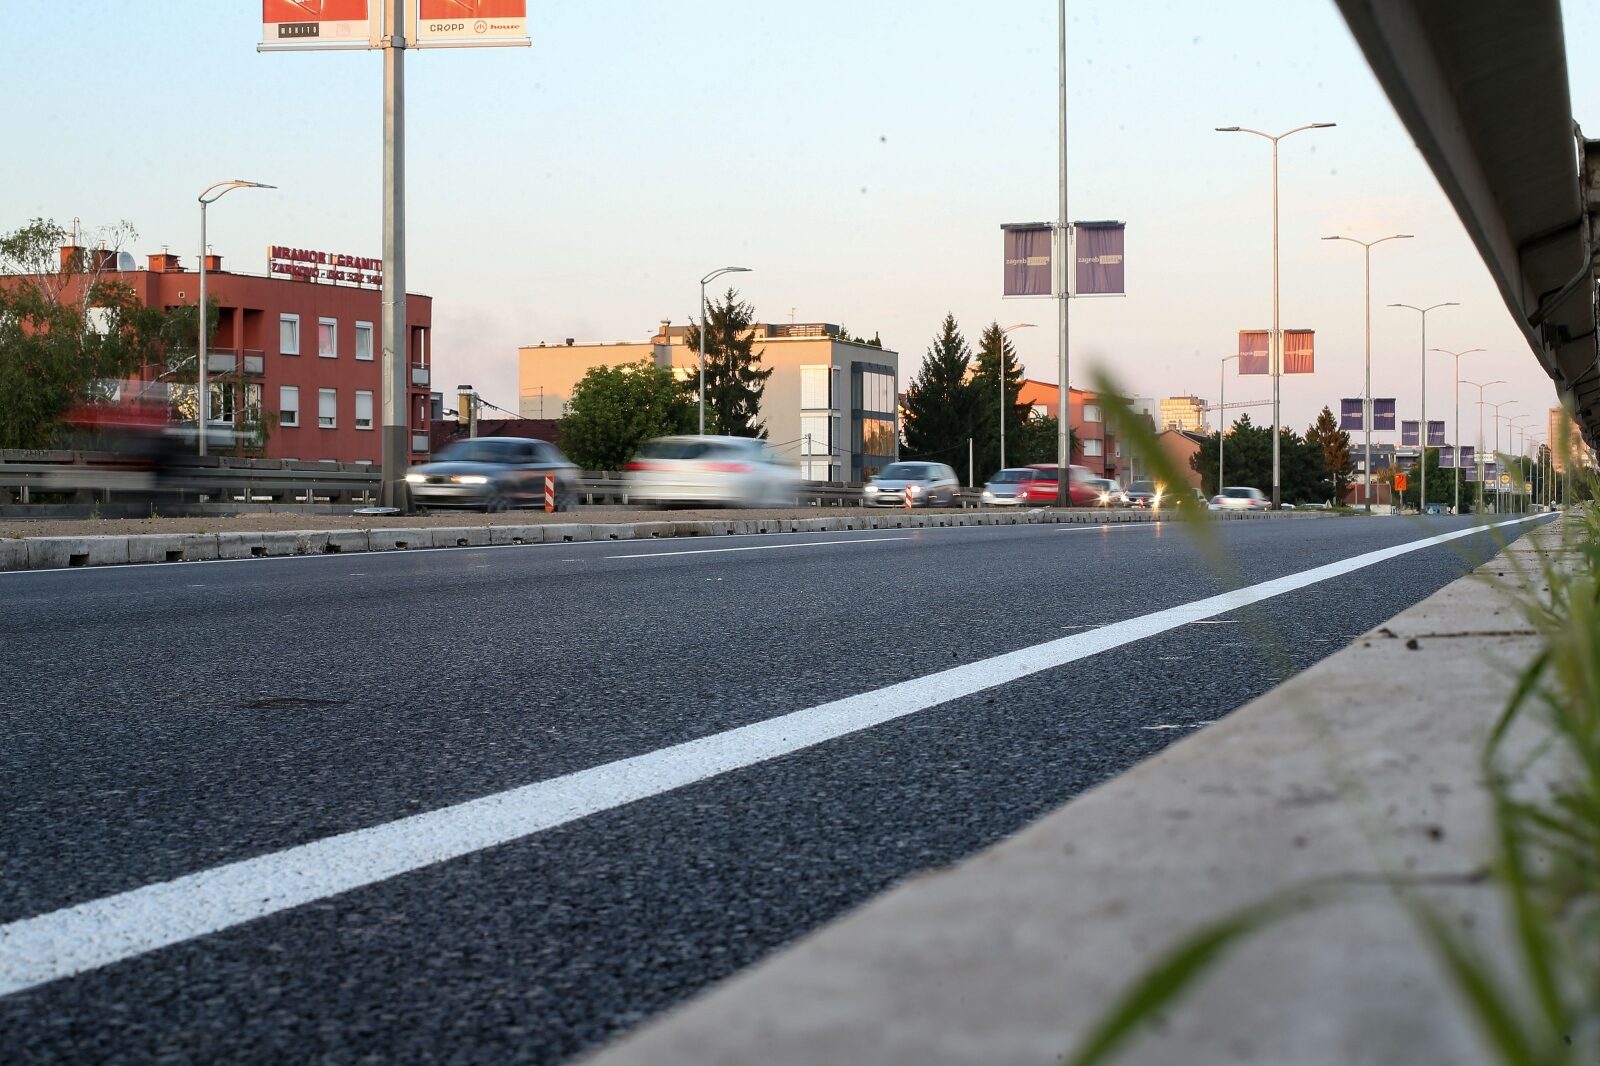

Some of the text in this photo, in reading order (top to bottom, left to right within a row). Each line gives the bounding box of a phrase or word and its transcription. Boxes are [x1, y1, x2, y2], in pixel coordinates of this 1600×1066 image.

[430, 24, 465, 32] CROPP
[272, 245, 326, 264] MRAMOR
[1006, 257, 1027, 266] zagreb
[1078, 255, 1100, 264] zagreb
